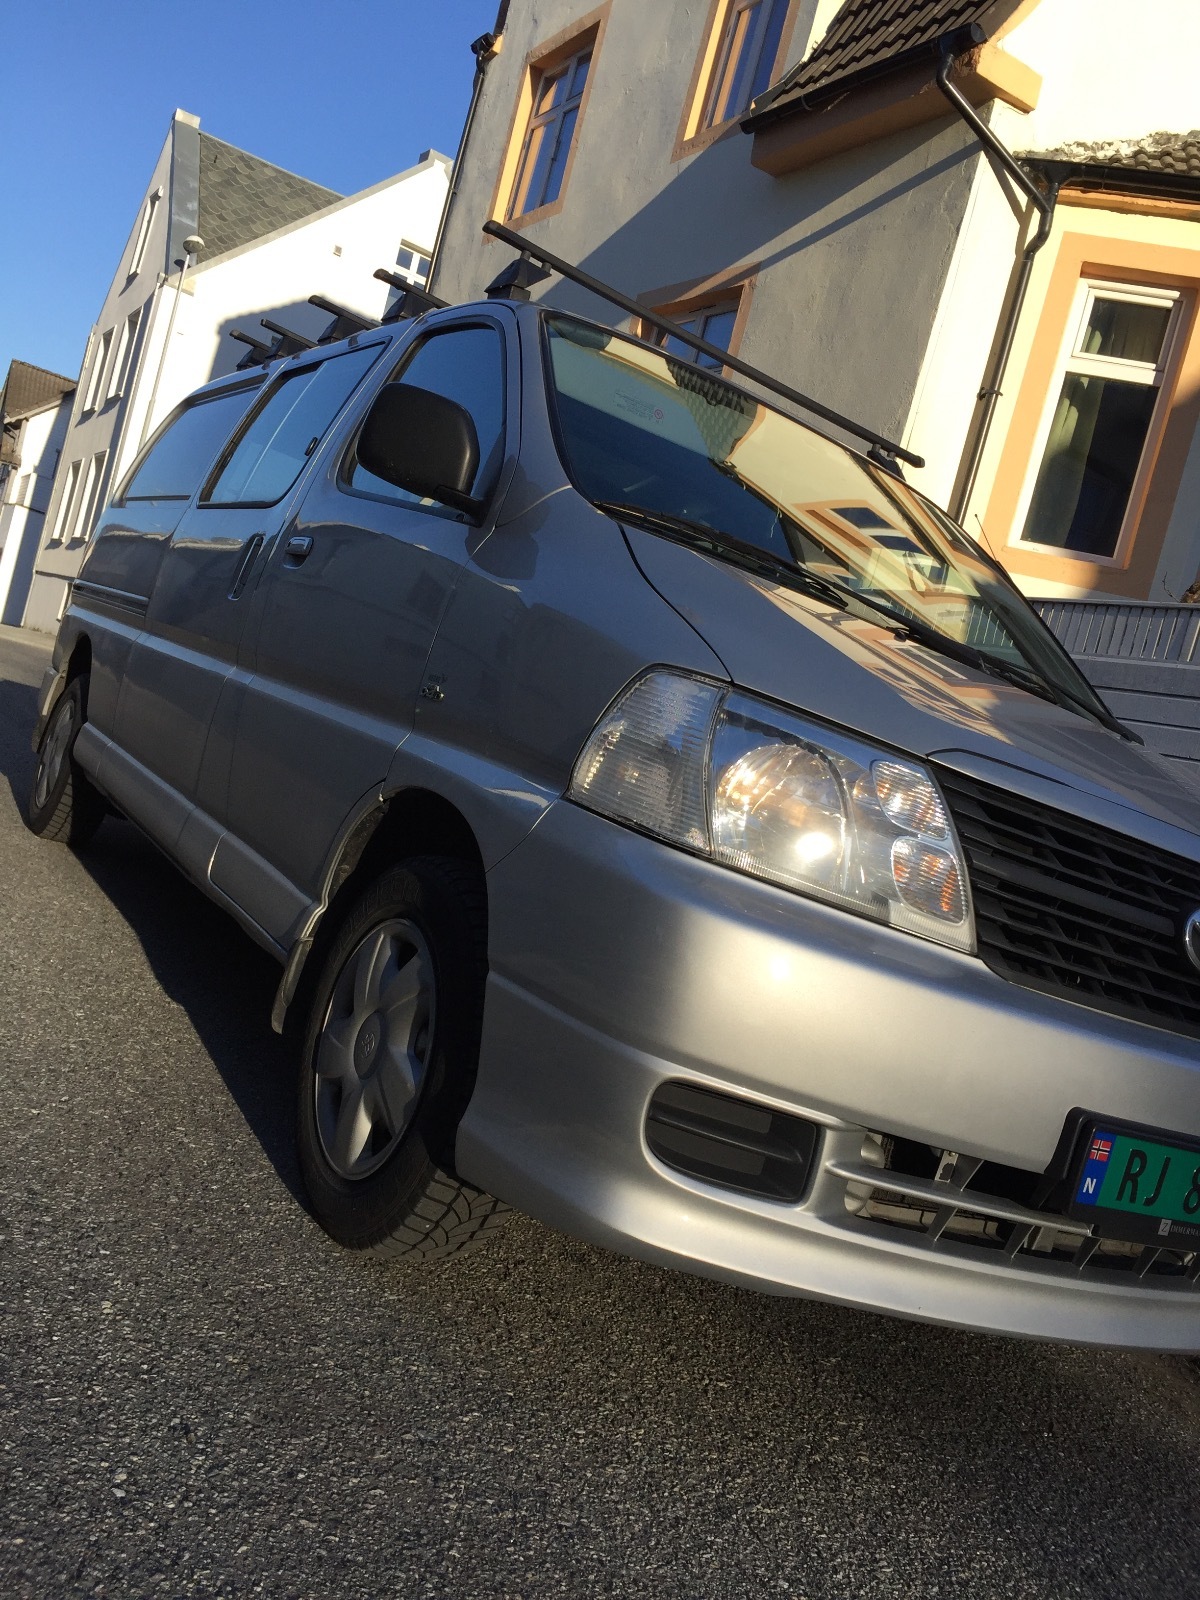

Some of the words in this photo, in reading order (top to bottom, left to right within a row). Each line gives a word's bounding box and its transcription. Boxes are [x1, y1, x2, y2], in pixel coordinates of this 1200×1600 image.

[1082, 1177, 1096, 1194] N
[1116, 1148, 1171, 1206] RJ
[1159, 1220, 1200, 1237] ZIMMERMA
